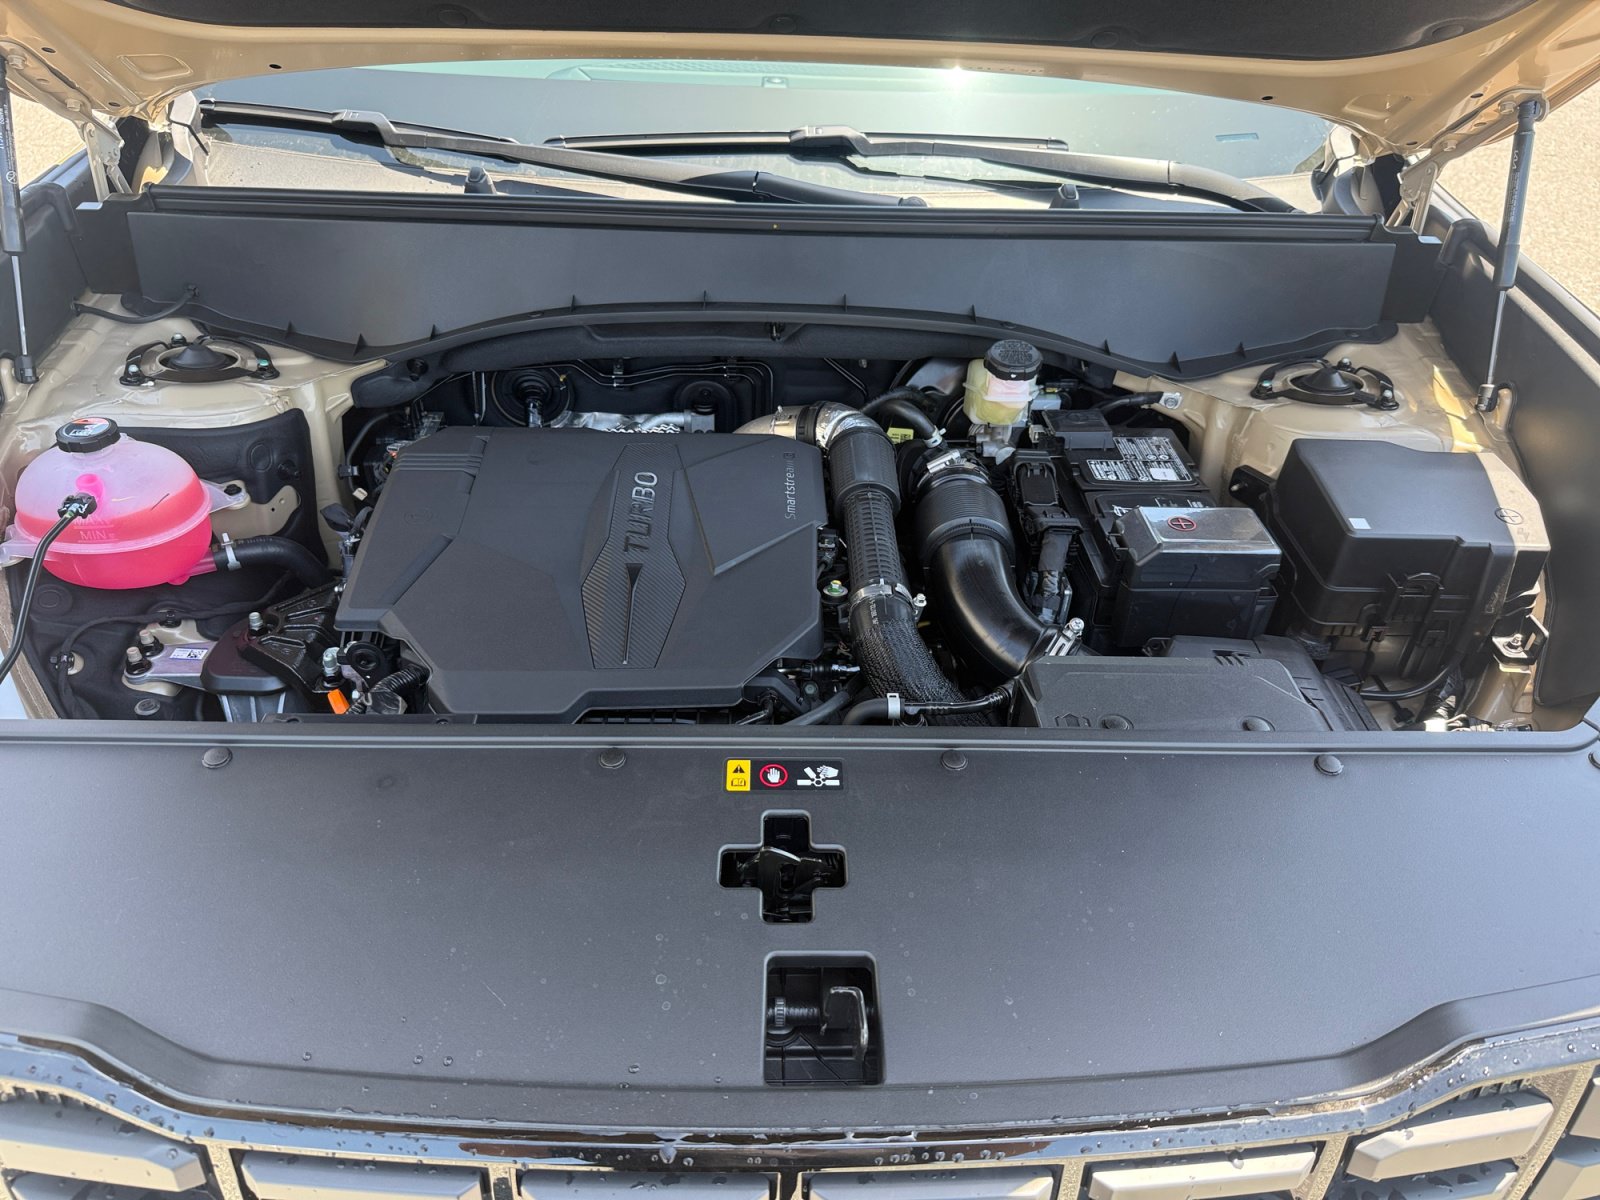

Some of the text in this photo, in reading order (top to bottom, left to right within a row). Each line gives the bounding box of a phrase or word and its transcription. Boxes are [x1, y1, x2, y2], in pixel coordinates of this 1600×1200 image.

[624, 472, 658, 552] TURBO
[784, 460, 796, 520] Smartstream
[80, 530, 106, 540] MIN
